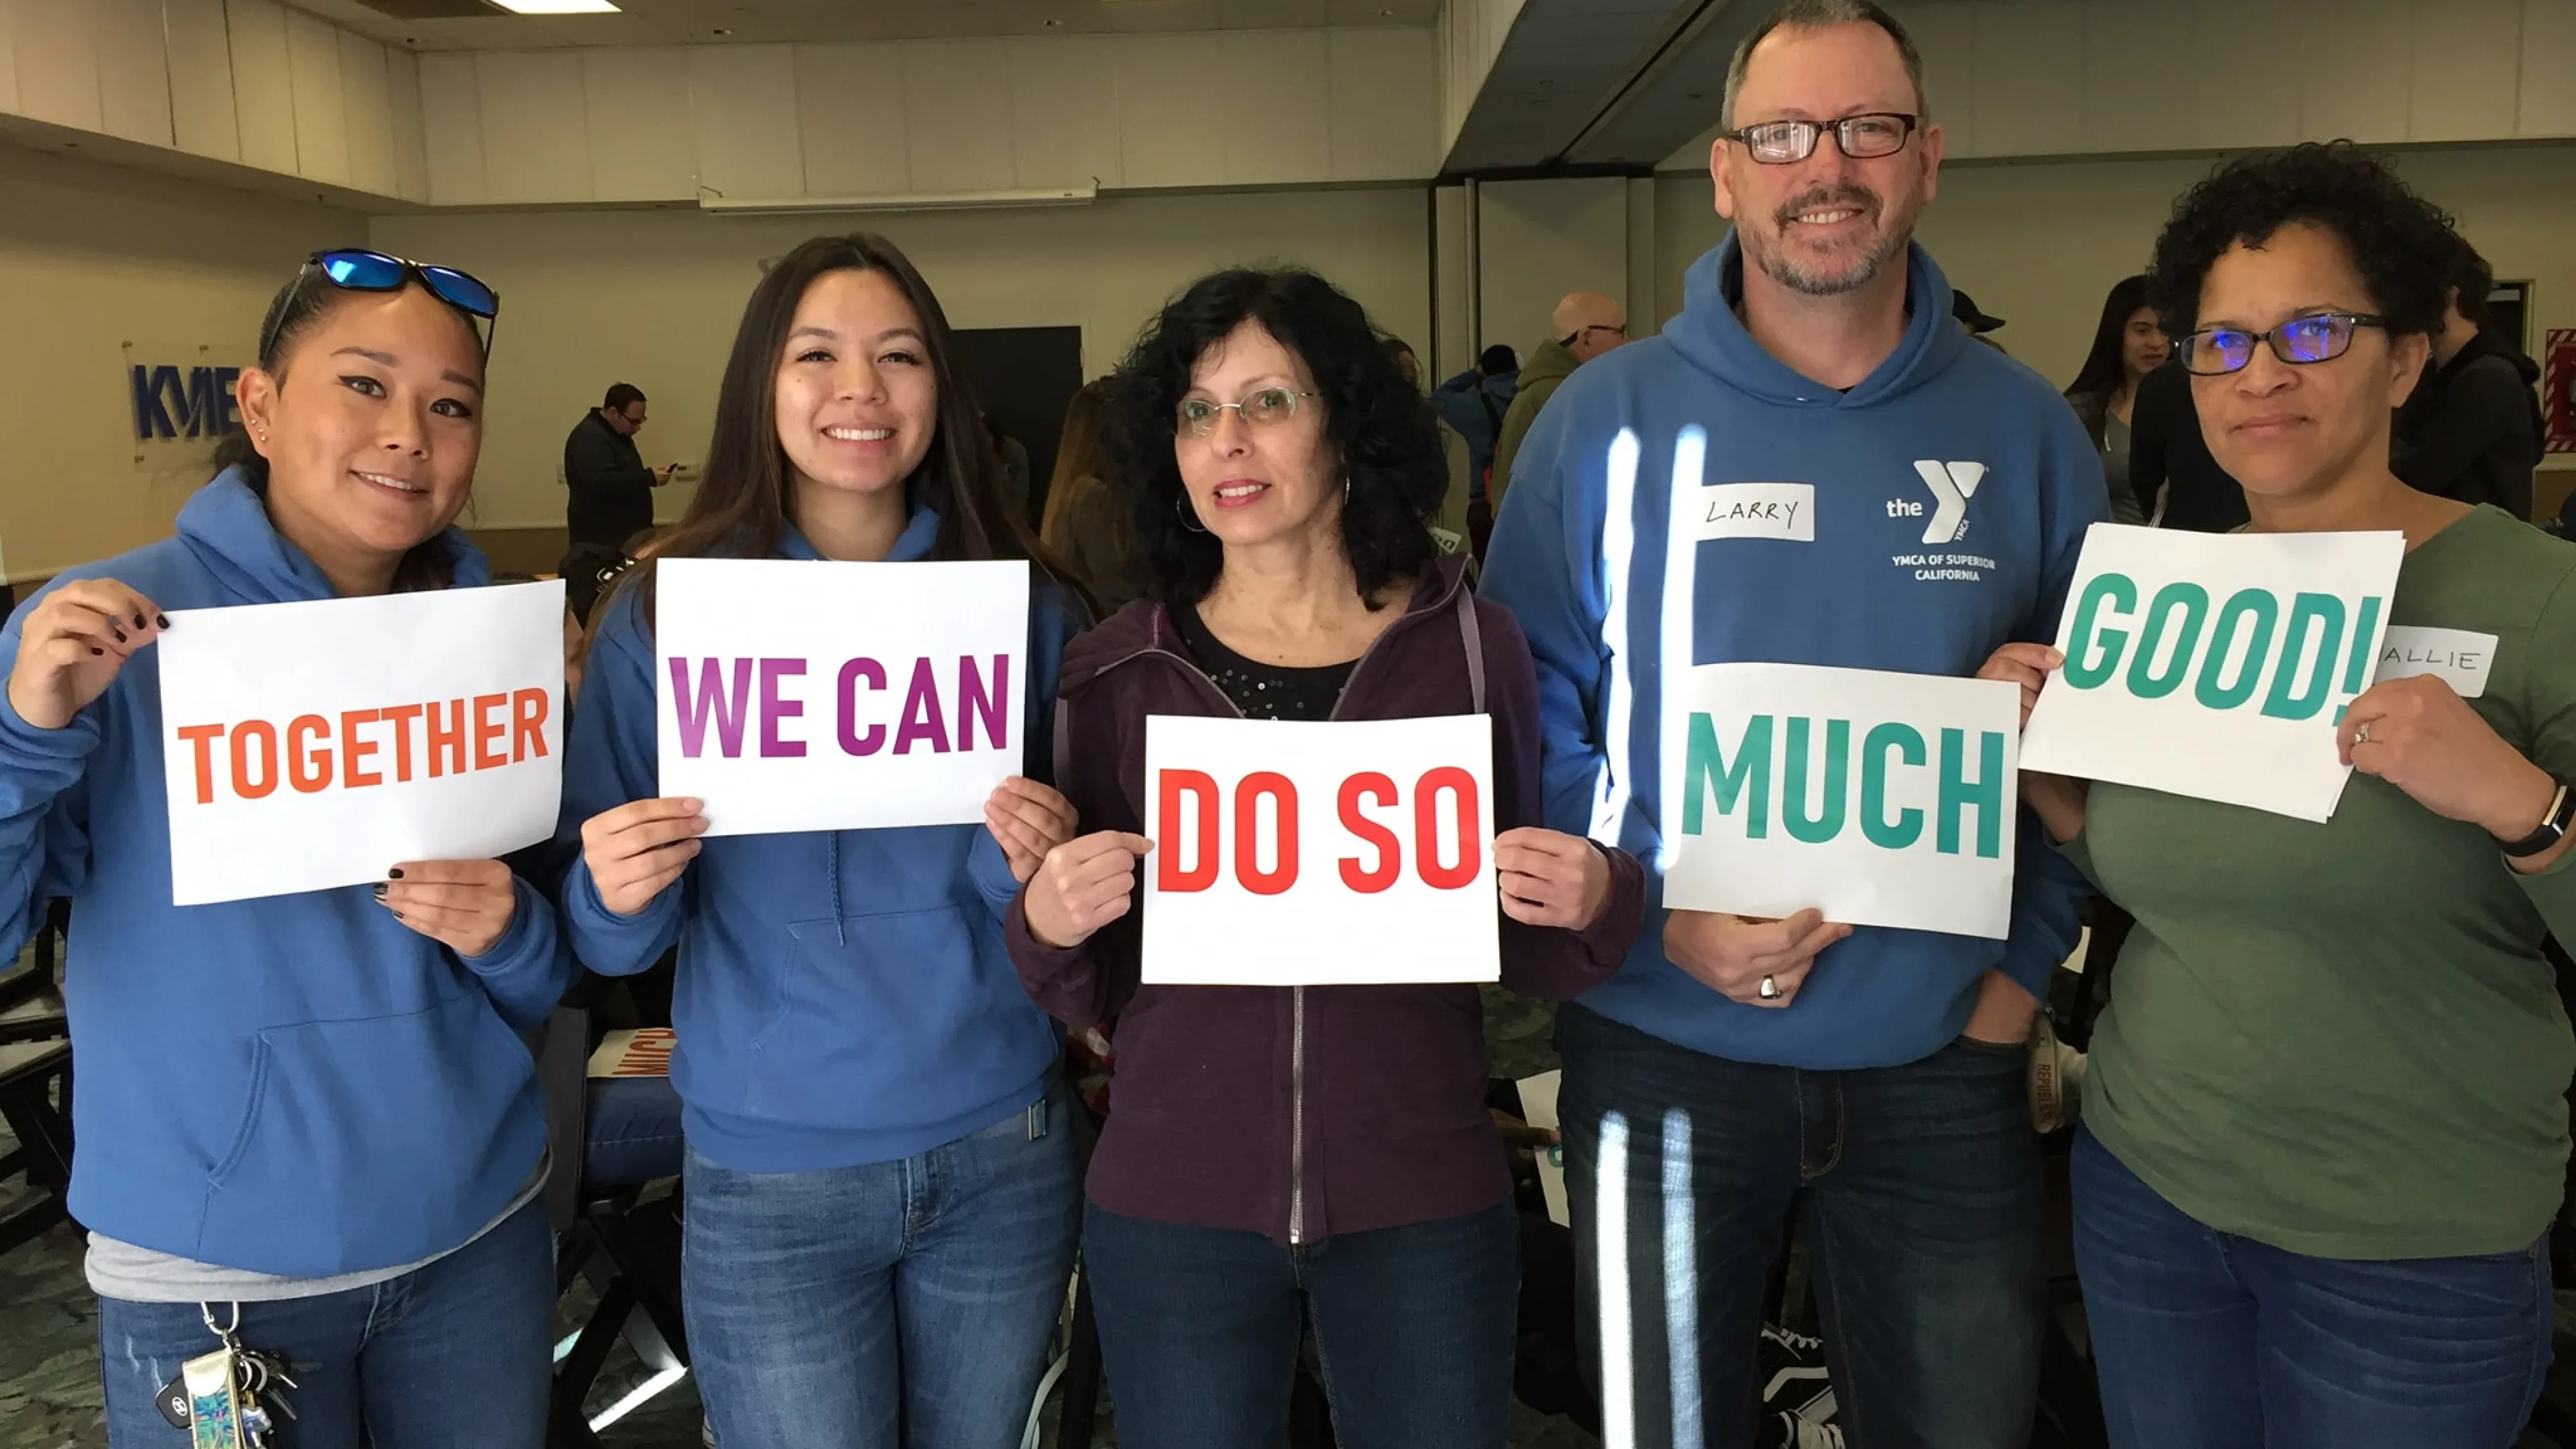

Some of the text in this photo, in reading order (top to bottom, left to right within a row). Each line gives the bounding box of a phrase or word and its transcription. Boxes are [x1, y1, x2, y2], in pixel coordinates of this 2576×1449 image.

[135, 364, 241, 438] KVIE
[1706, 500, 1799, 530] LARRY
[1886, 498, 1923, 518] the
[1953, 519, 1971, 541] YMCA
[1891, 554, 1996, 570] YMCA OF SUPERIOR
[1915, 569, 1980, 582] CALIFORNIA
[2063, 572, 2382, 727] GOOD!
[2379, 645, 2481, 670] ALLIE
[668, 653, 1009, 758] WE CAN
[176, 687, 549, 804] TOGETHER
[1682, 712, 2004, 859] MUCH
[1157, 766, 1481, 896] DO SO
